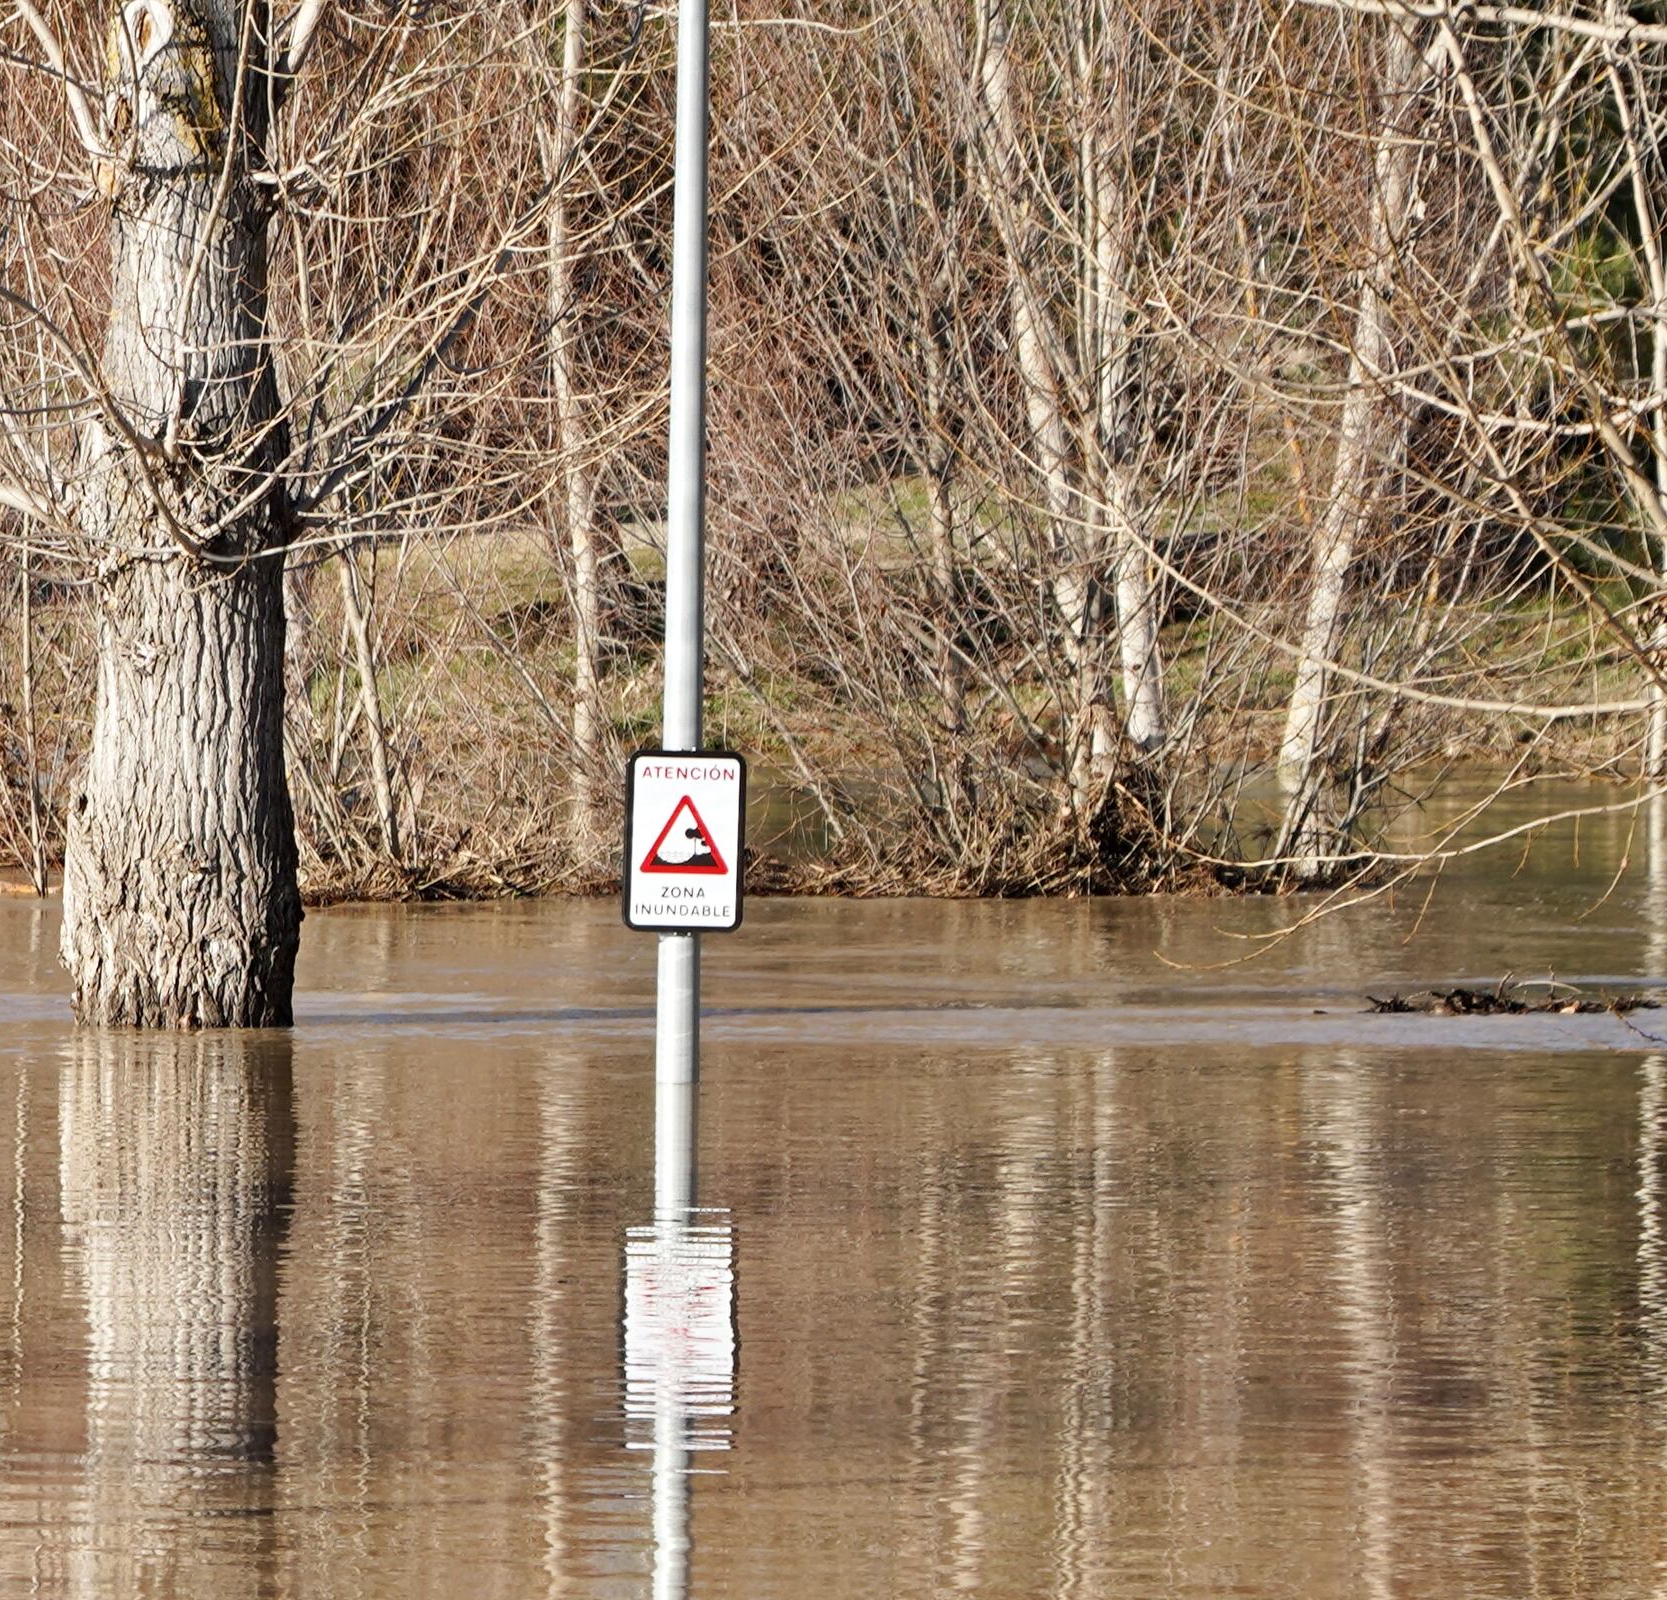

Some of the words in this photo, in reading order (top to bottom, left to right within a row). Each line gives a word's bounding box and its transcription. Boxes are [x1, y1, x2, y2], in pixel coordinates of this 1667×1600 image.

[642, 765, 735, 781] ATENCIÓN
[661, 886, 706, 899] ZONA
[635, 904, 731, 917] INUNDABLE
